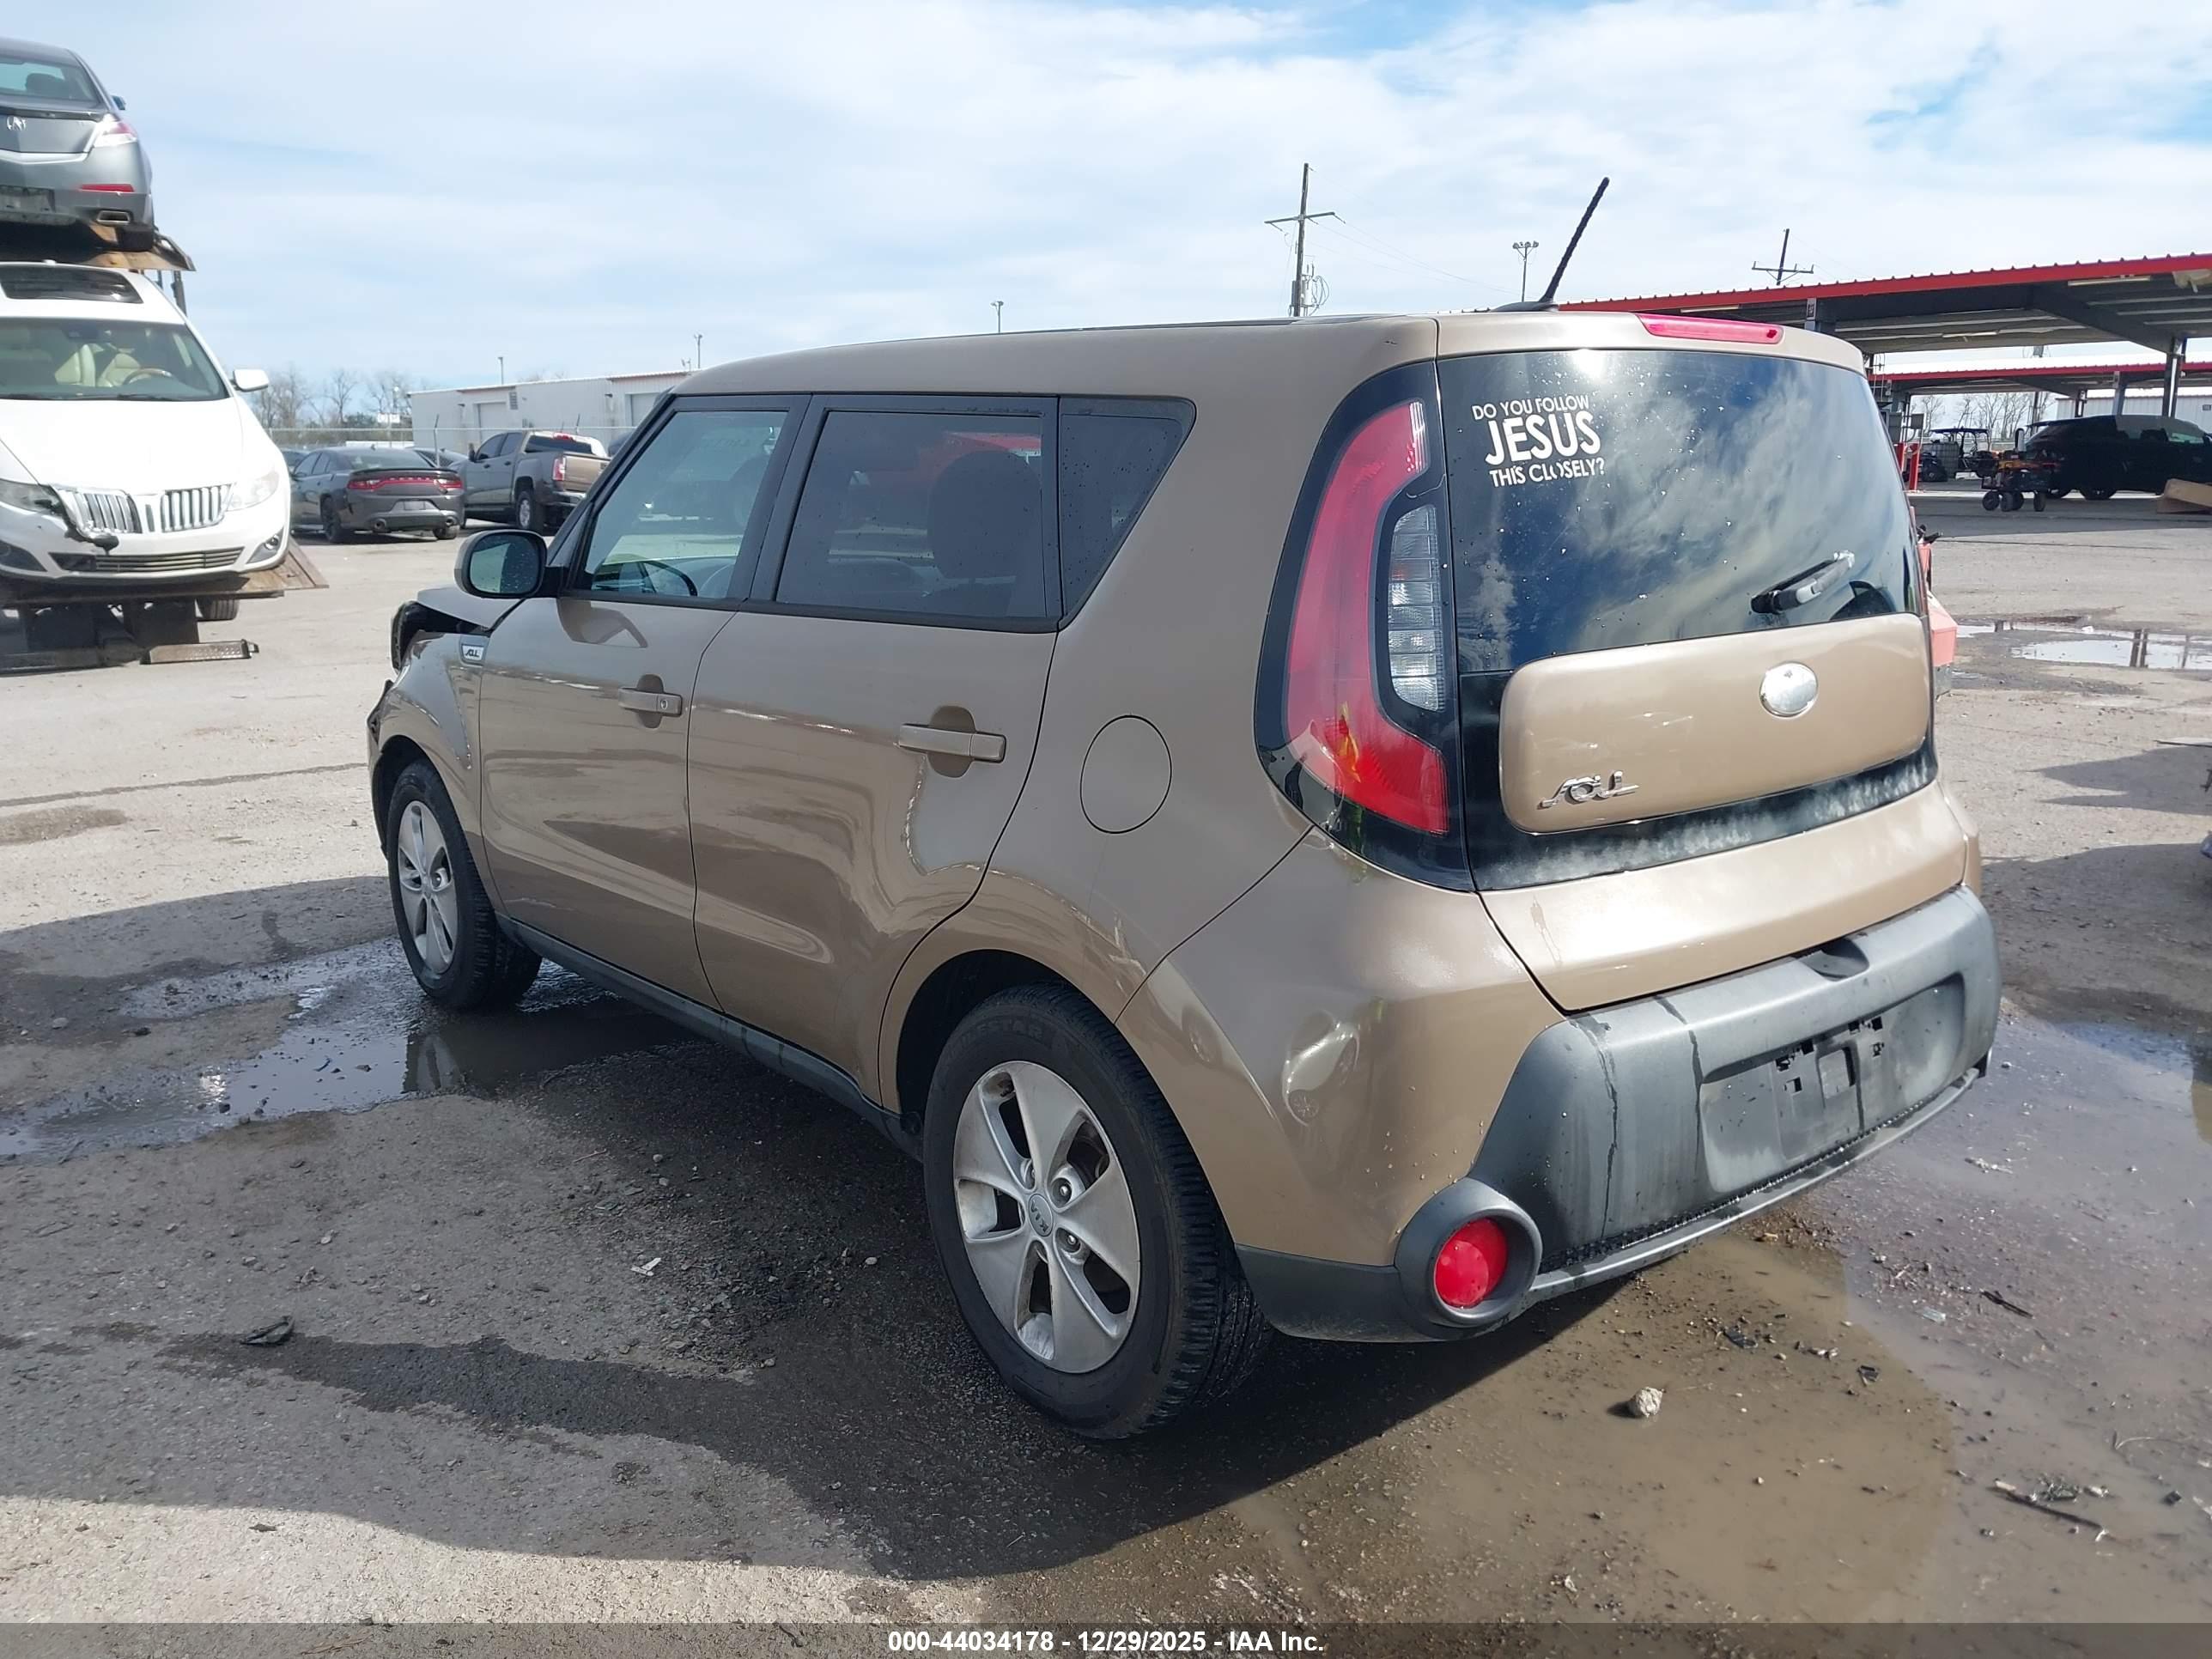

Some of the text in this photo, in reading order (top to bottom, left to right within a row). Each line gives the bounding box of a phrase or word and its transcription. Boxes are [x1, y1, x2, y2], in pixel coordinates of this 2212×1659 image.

[1472, 395, 1589, 421] DO YOU FOLLOW
[1485, 410, 1601, 465] JESUS
[1489, 465, 1526, 487] THIS
[1030, 1200, 1049, 1232] KIA
